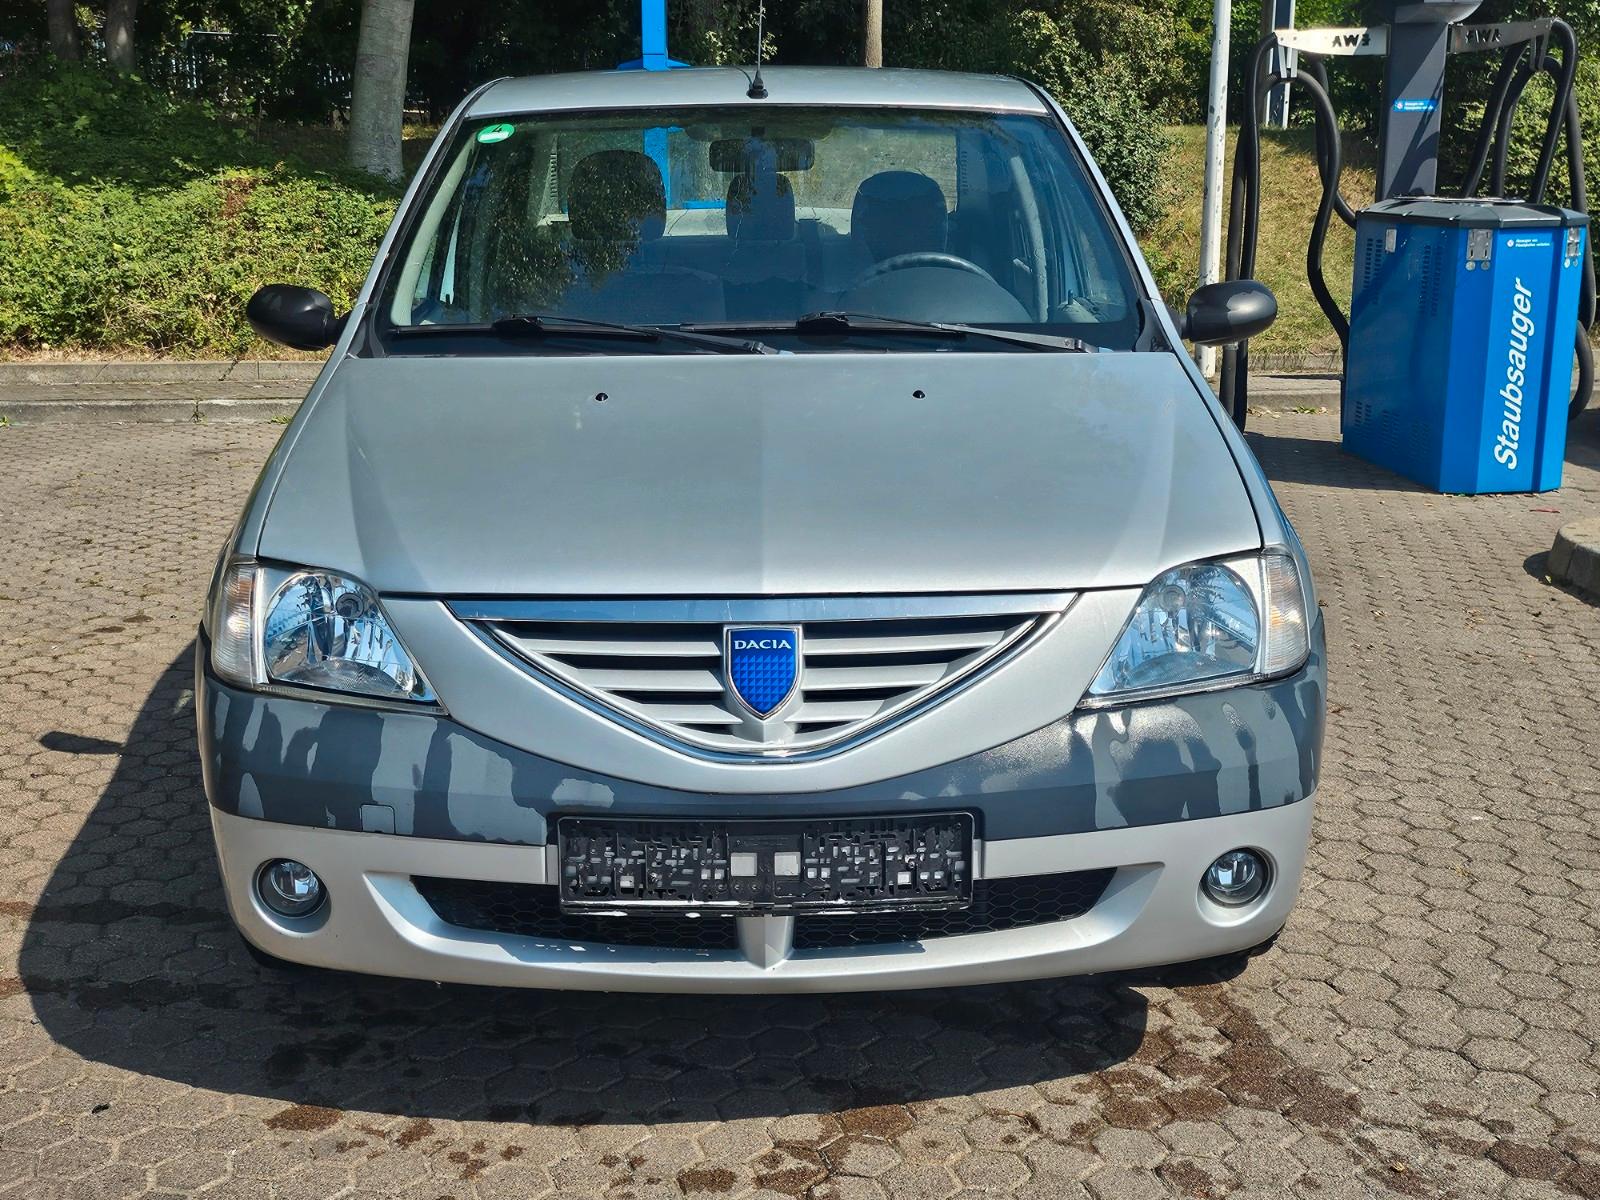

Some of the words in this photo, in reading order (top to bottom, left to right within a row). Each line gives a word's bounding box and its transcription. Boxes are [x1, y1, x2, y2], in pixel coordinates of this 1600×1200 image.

[491, 124, 503, 133] 4
[1494, 277, 1535, 470] Staubsauger
[734, 639, 792, 650] DACIA
